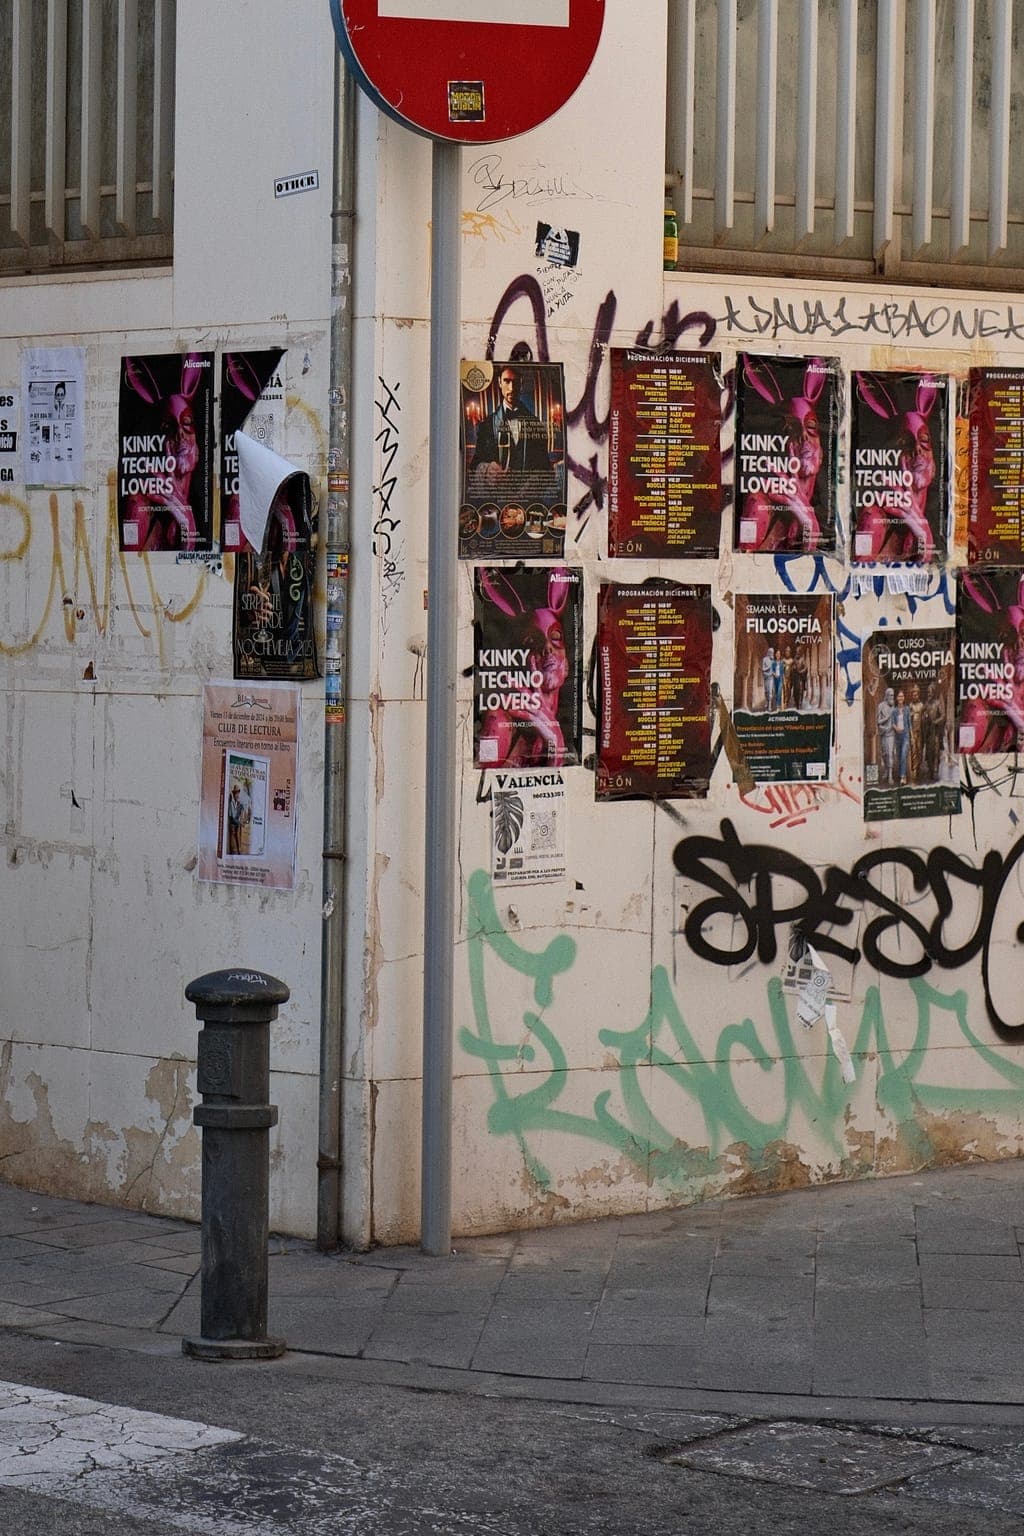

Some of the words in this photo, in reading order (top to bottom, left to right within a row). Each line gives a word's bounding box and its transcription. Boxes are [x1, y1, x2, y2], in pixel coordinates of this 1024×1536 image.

[183, 359, 211, 368] Alicante
[675, 356, 707, 364] DICIEMBRE
[806, 364, 836, 374] Alicante
[918, 379, 946, 389] Alicante
[123, 434, 166, 453] KINKY
[741, 434, 789, 451] KINKY
[122, 456, 176, 474] TECHNO
[610, 409, 619, 513] #electronicmusic
[740, 455, 801, 474] TECHNO
[856, 449, 902, 466] KINKY
[122, 478, 174, 496] LOVERS
[740, 476, 797, 494] LOVERS
[856, 470, 914, 487] TECHNO
[855, 490, 912, 508] LOVERS
[550, 574, 580, 583] Alicante
[617, 589, 664, 597] PROGRAMACIÓN
[746, 605, 775, 614] SEMANA
[778, 606, 786, 614] DE
[746, 615, 821, 634] FILOSOFÍA
[795, 636, 823, 644] ACTIVA
[898, 638, 925, 649] CURSO
[479, 649, 530, 667] KINKY
[961, 642, 1004, 659] KINKY
[479, 671, 544, 689] TECHNO
[892, 670, 913, 680] PARA
[914, 669, 937, 680] VIVIR
[960, 663, 1015, 680] TECHNO
[602, 646, 613, 748] #electronicmusic
[959, 683, 1014, 700] LOVERS
[479, 693, 542, 711] LOVERS
[218, 722, 236, 733] CLUB
[238, 724, 248, 734] DE
[249, 725, 282, 736] LECTURA
[214, 738, 235, 747] Encuentro
[236, 739, 254, 748] literario
[261, 741, 273, 750] torno
[274, 742, 279, 751] al
[279, 742, 291, 752] libro
[284, 778, 292, 818] Lectura
